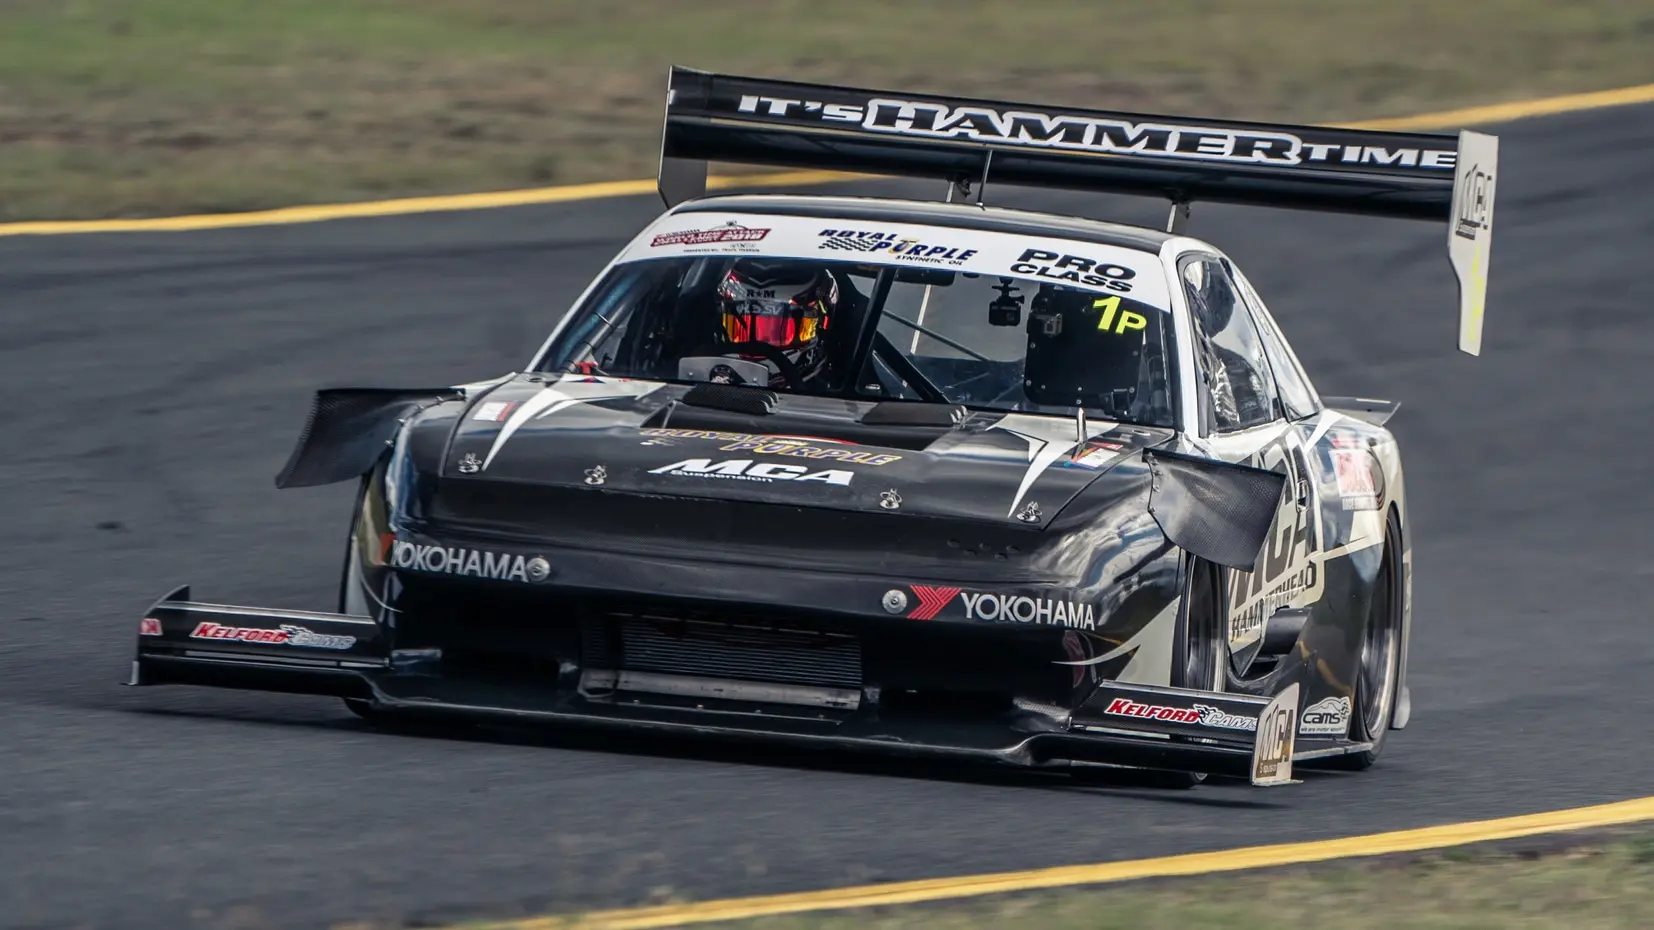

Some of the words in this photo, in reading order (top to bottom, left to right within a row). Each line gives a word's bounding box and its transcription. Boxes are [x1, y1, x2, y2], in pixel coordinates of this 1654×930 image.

[818, 229, 898, 241] ROYAL
[869, 238, 979, 260] PURPLE
[895, 254, 944, 264] SYNTHETIC
[1017, 248, 1136, 280] PRO
[1010, 263, 1133, 292] CLASS
[719, 440, 902, 464] PURPLE
[647, 458, 854, 486] MCA
[960, 592, 1096, 631] YOKOHAMA
[191, 621, 289, 644] KELFORD
[1106, 700, 1199, 723] KELFORD
